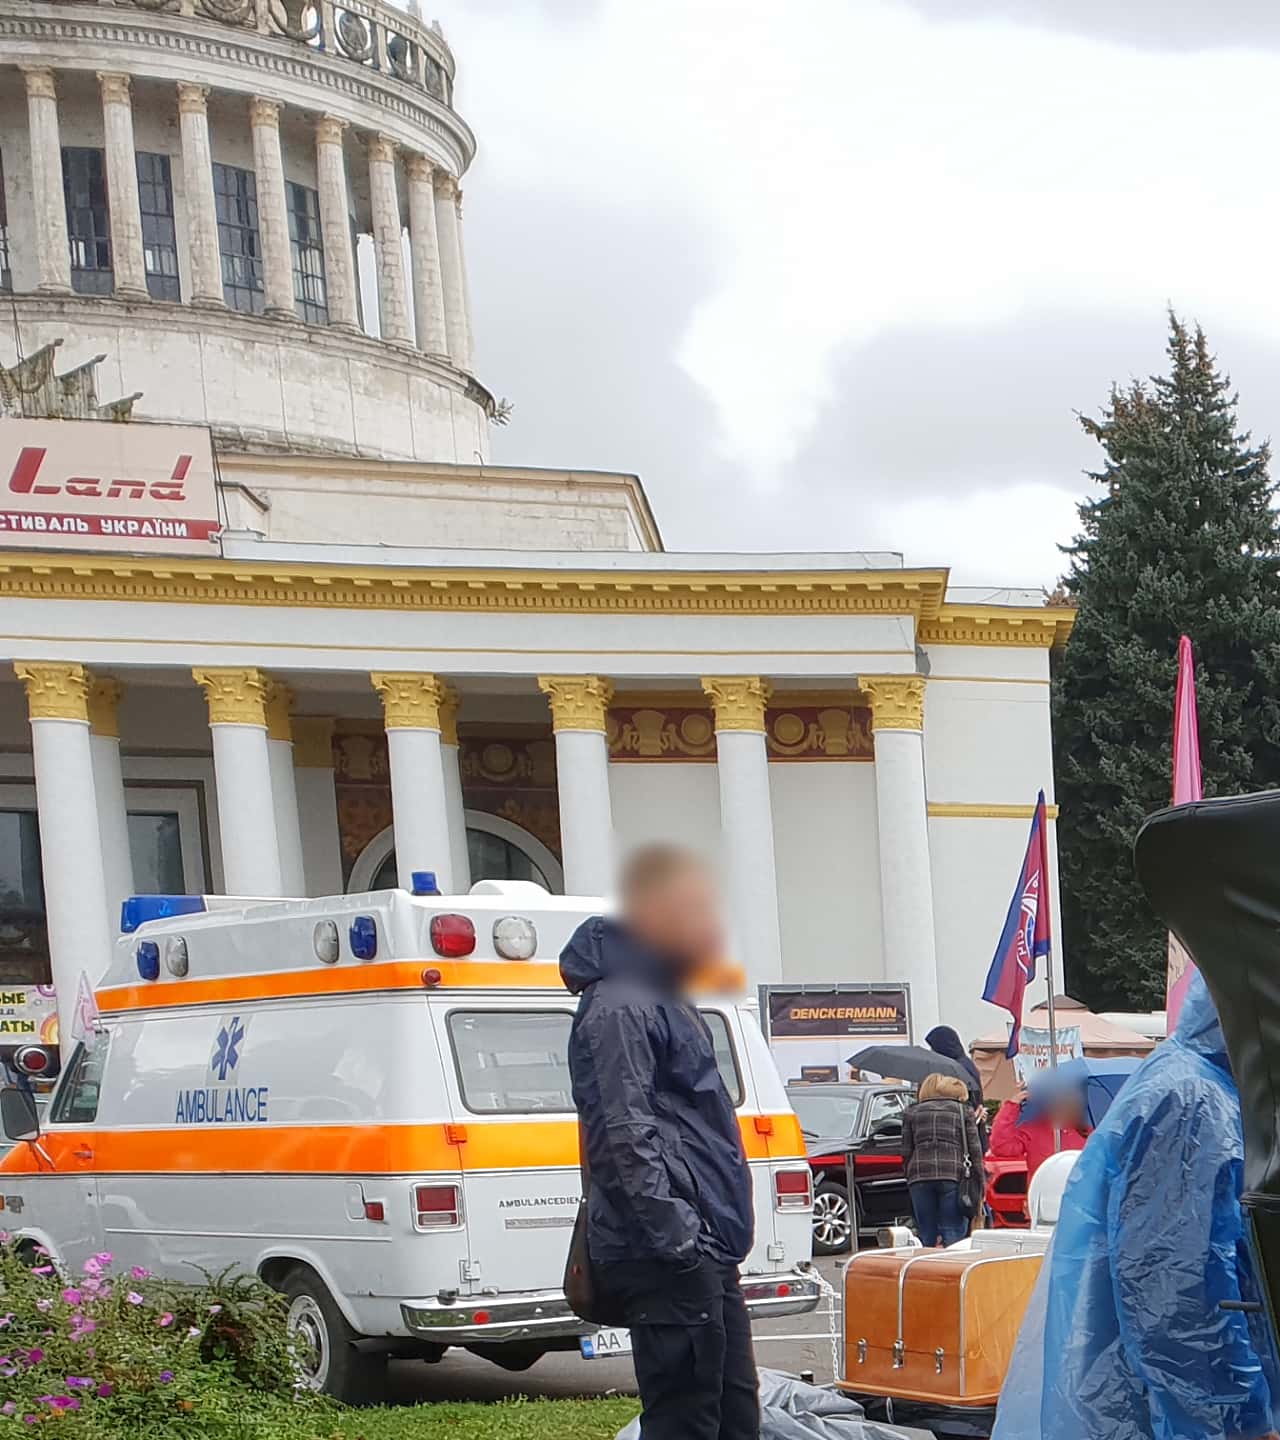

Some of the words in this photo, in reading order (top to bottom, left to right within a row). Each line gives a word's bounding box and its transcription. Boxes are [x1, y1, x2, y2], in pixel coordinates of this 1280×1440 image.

[9, 447, 192, 500] Land
[101, 518, 188, 537] УКРАЇНИ
[790, 1007, 897, 1020] DENCKERMANN
[176, 1087, 268, 1123] AMBULANCE
